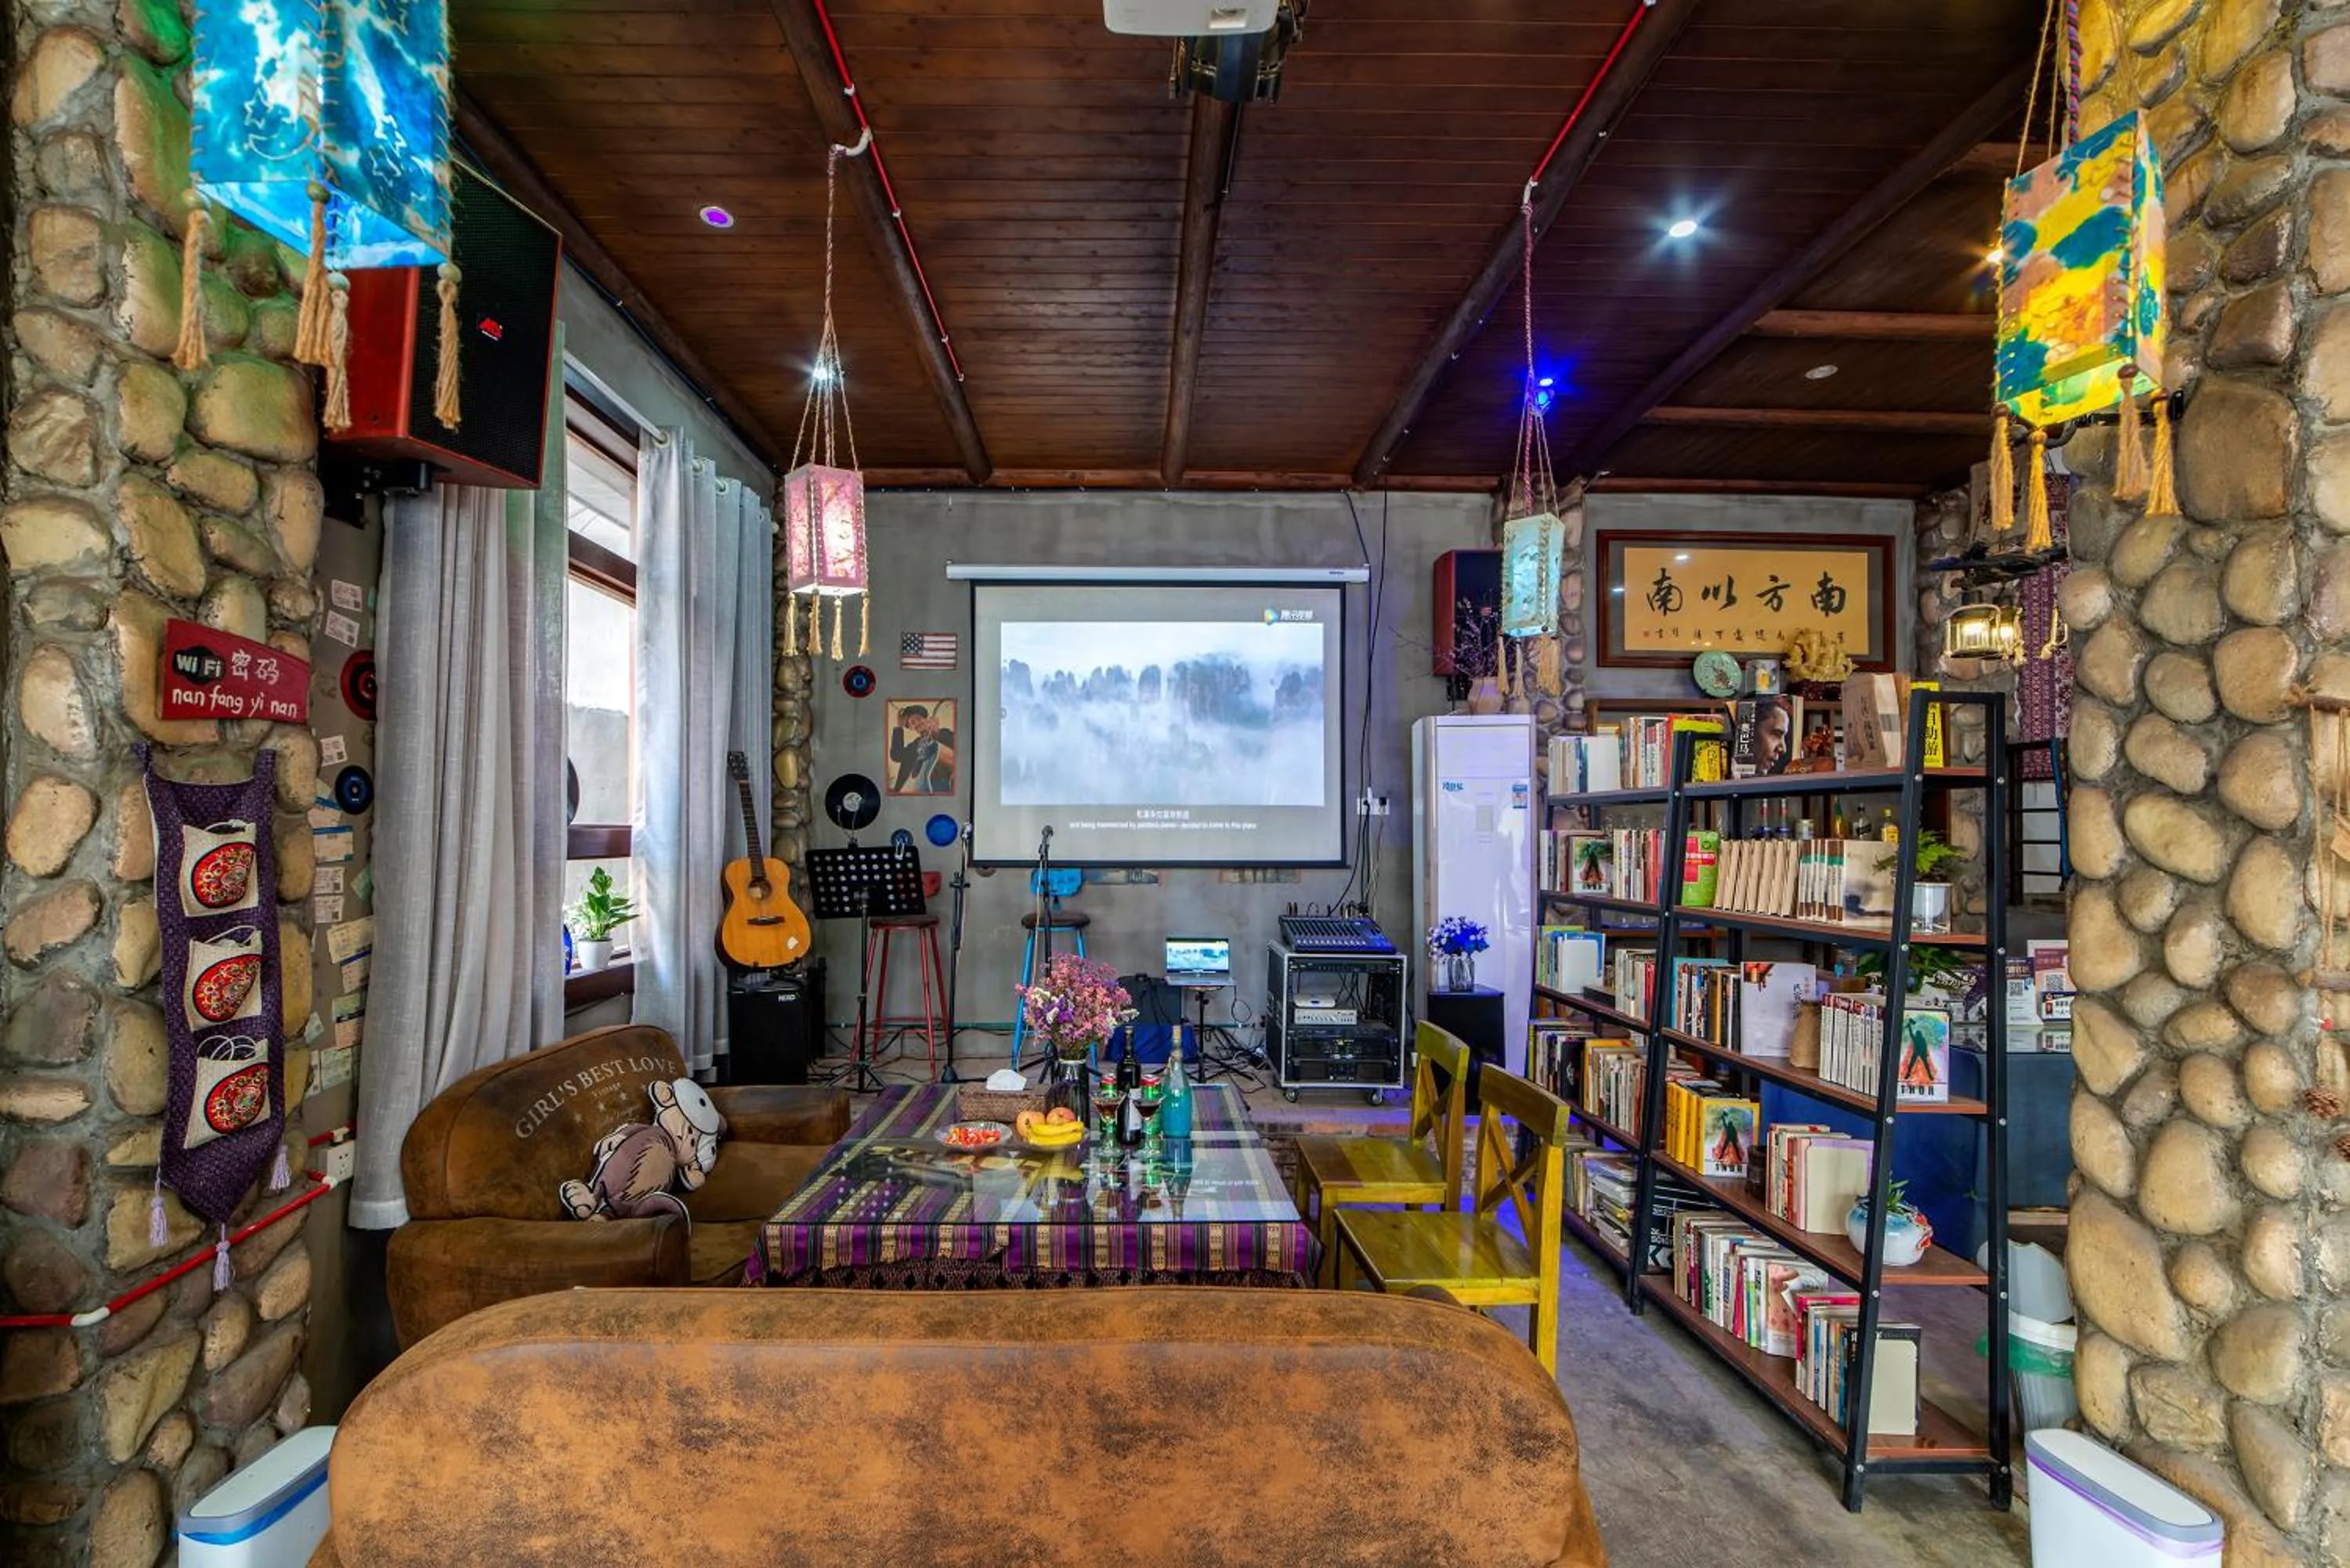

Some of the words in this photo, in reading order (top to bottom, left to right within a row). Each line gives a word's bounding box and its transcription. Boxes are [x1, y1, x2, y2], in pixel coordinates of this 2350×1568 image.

[231, 649, 280, 685] 密码
[172, 688, 205, 706] nan
[209, 685, 244, 714] fang
[248, 692, 265, 718] yi
[270, 699, 298, 719] nan
[515, 1080, 578, 1139] GIRL'S
[576, 1058, 627, 1090] BEST
[627, 1057, 678, 1075] LOVE
